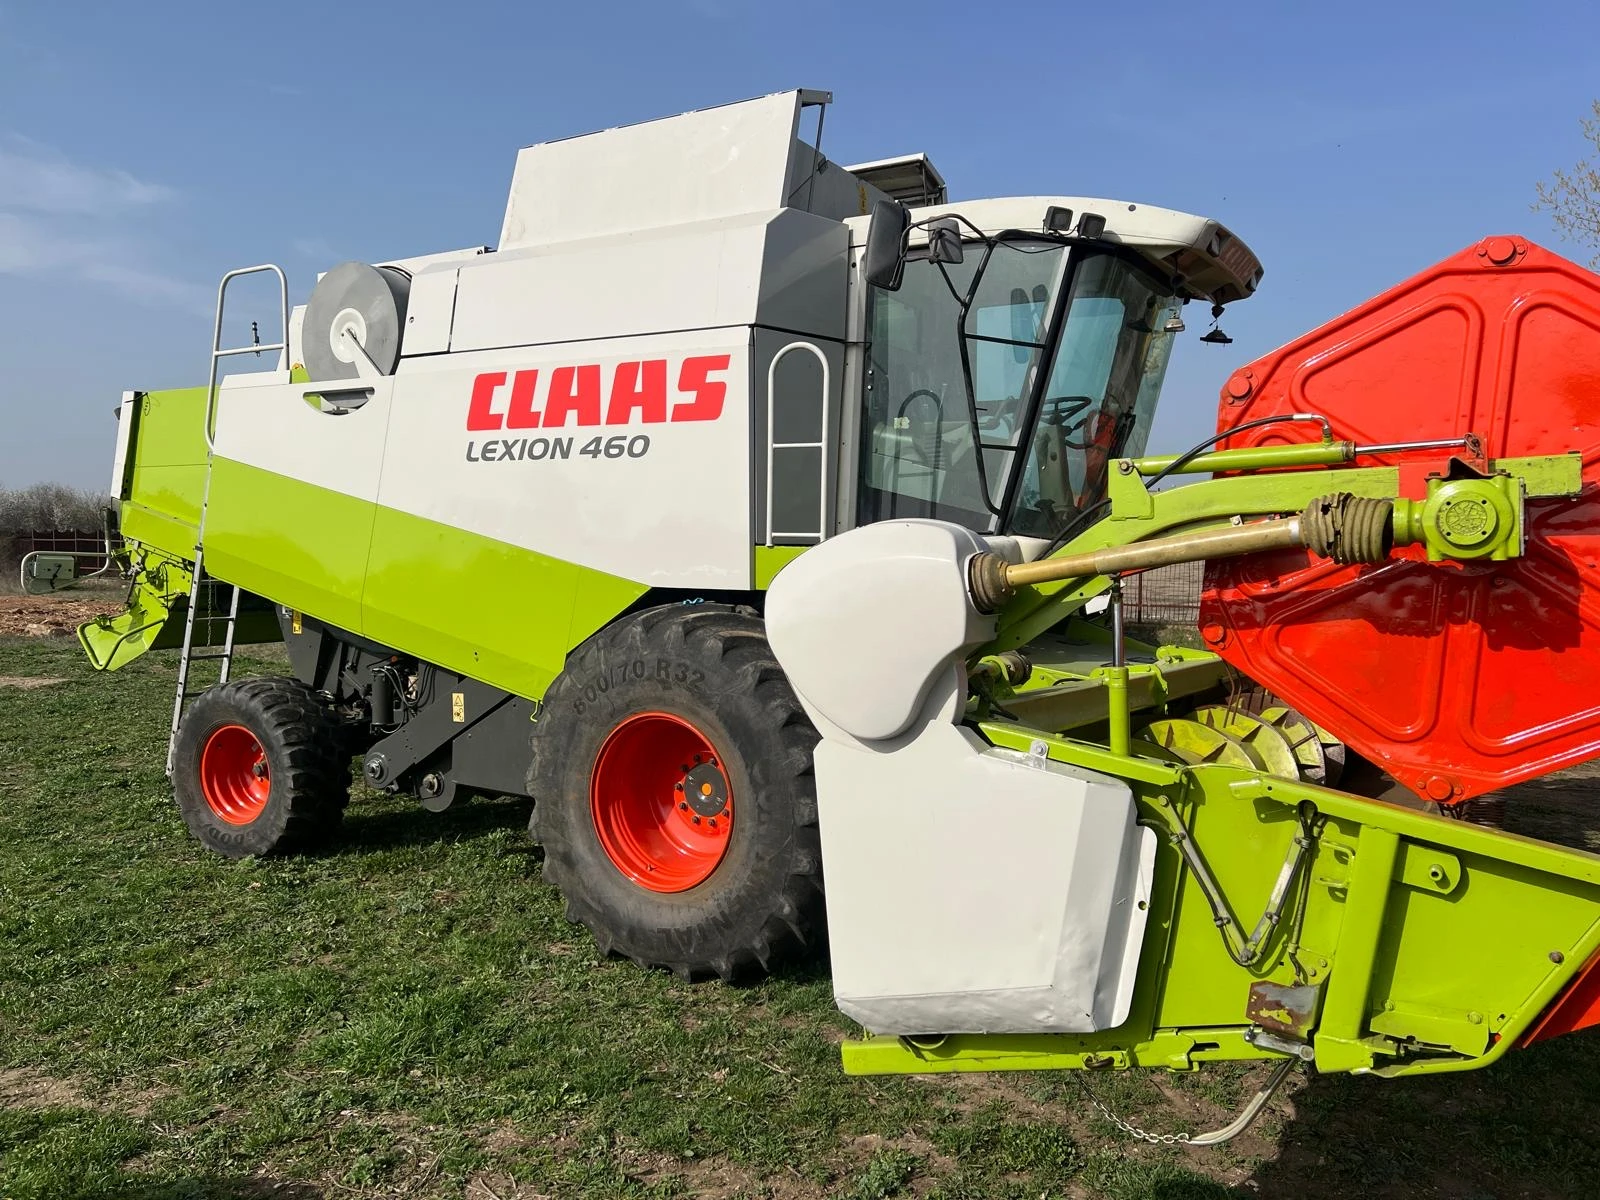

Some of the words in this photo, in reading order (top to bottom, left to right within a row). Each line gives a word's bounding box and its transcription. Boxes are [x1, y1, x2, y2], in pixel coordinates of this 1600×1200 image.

[466, 354, 731, 431] CLAAS
[466, 437, 574, 462] LEXION
[579, 434, 651, 460] 460
[656, 658, 706, 692] R32
